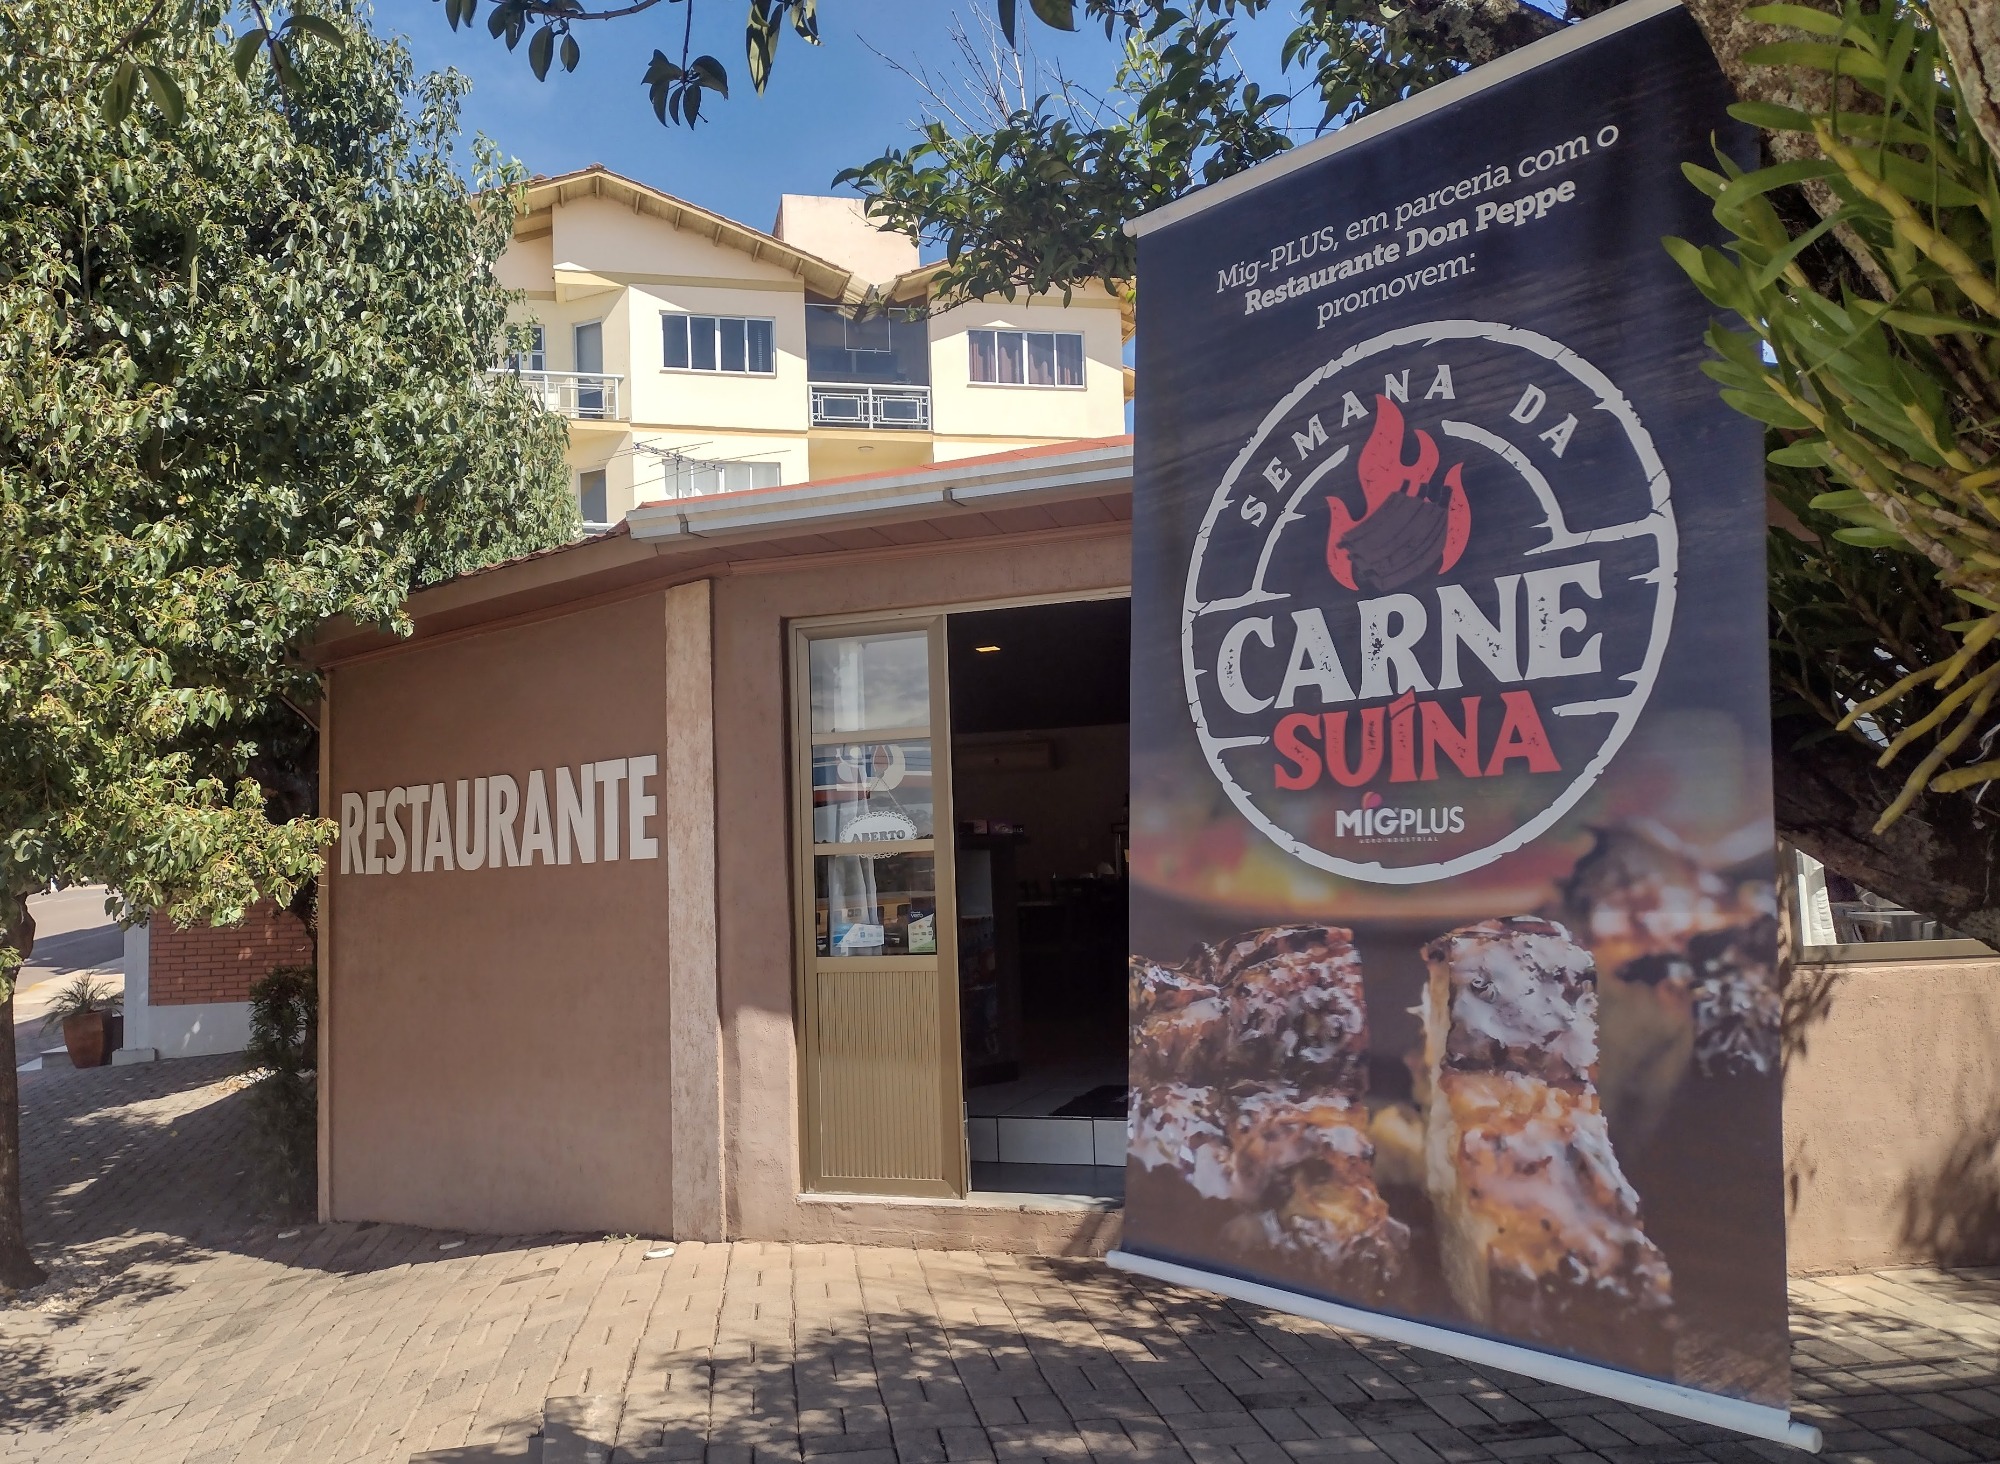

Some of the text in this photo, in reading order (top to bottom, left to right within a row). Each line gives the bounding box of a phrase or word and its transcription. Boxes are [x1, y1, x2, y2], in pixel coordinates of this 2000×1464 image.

[1216, 124, 1619, 293] Mig-PLUS, em parceria com o
[1244, 180, 1576, 315] Restaurante Don Peppe
[1316, 251, 1477, 329] promovem:
[1240, 364, 1579, 527] SEMANA DA
[1217, 560, 1602, 714] CARNE
[1273, 687, 1562, 790] SUÍNA
[341, 755, 658, 875] RESTAURANTE
[851, 830, 905, 843] ABERTO
